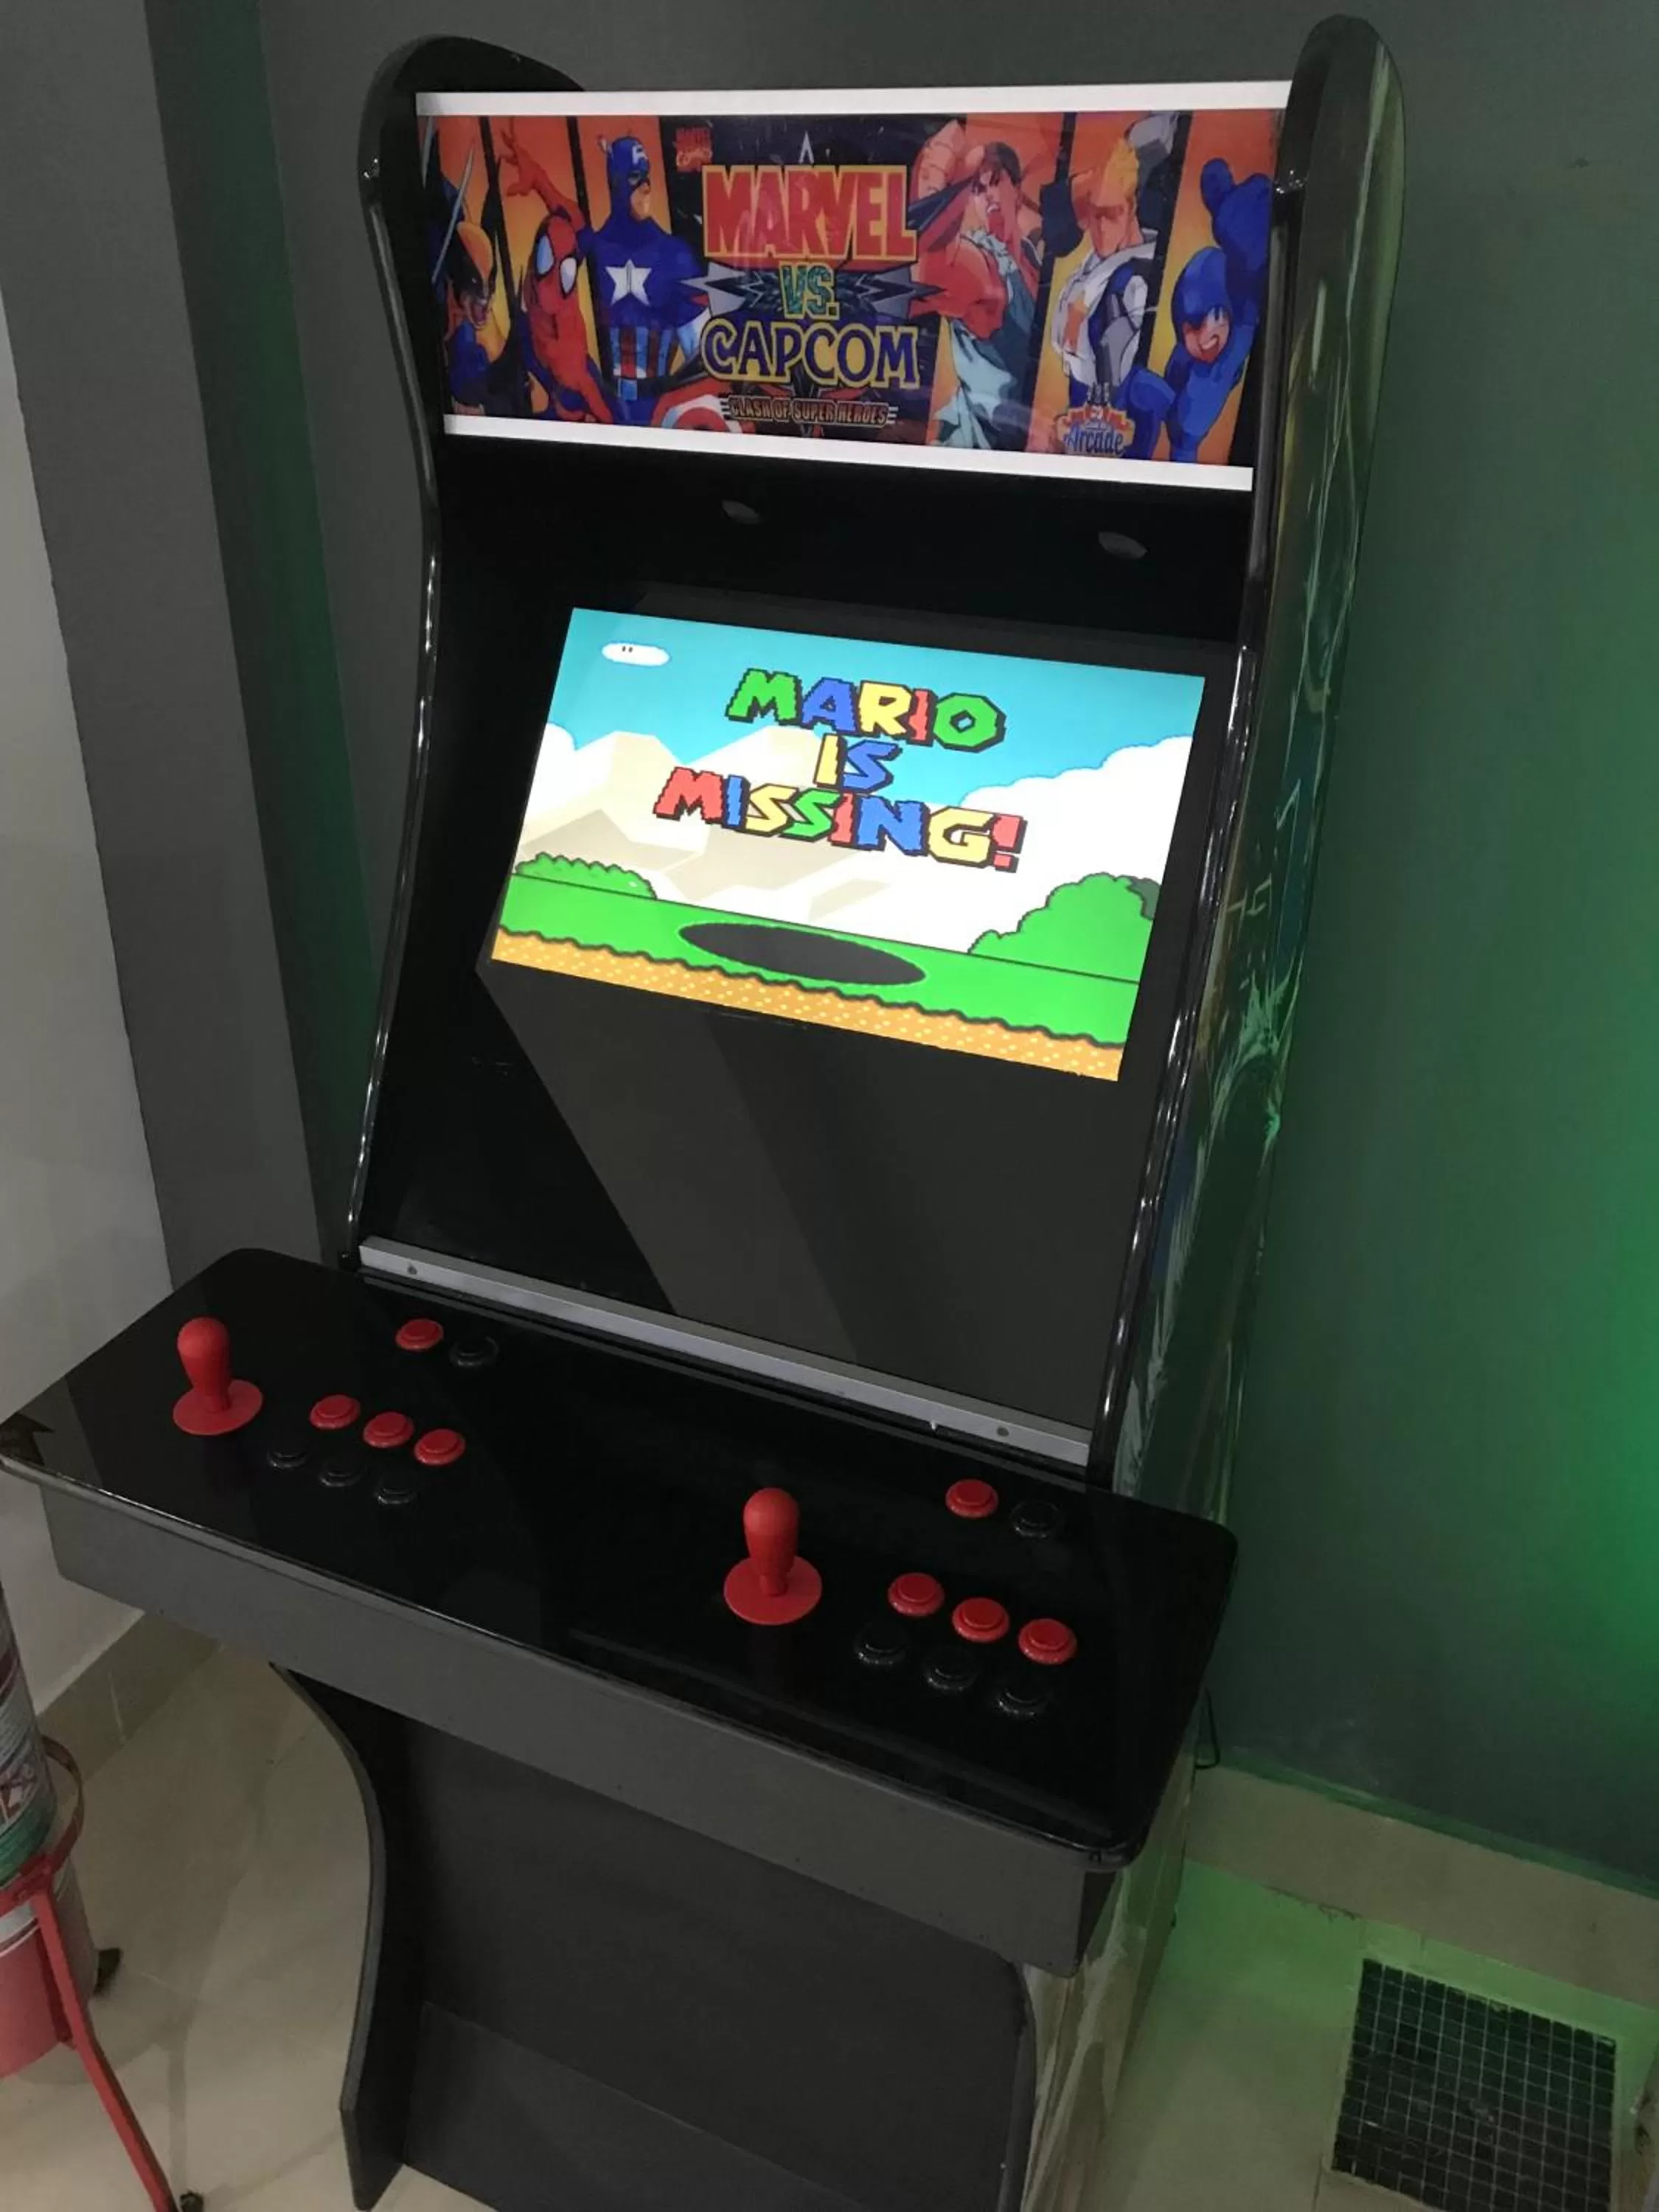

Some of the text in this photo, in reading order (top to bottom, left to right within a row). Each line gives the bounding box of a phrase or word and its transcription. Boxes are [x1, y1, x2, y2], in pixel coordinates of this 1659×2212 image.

[703, 164, 918, 261] MARVEL
[779, 260, 840, 320] VS.
[701, 318, 919, 389] CAPCOM
[730, 397, 887, 425] CLASH OF SUPER HEROES
[1063, 420, 1124, 455] Arcade
[725, 668, 1006, 753] MARIO
[813, 733, 902, 793] IS
[653, 767, 1028, 872] MISSING!
